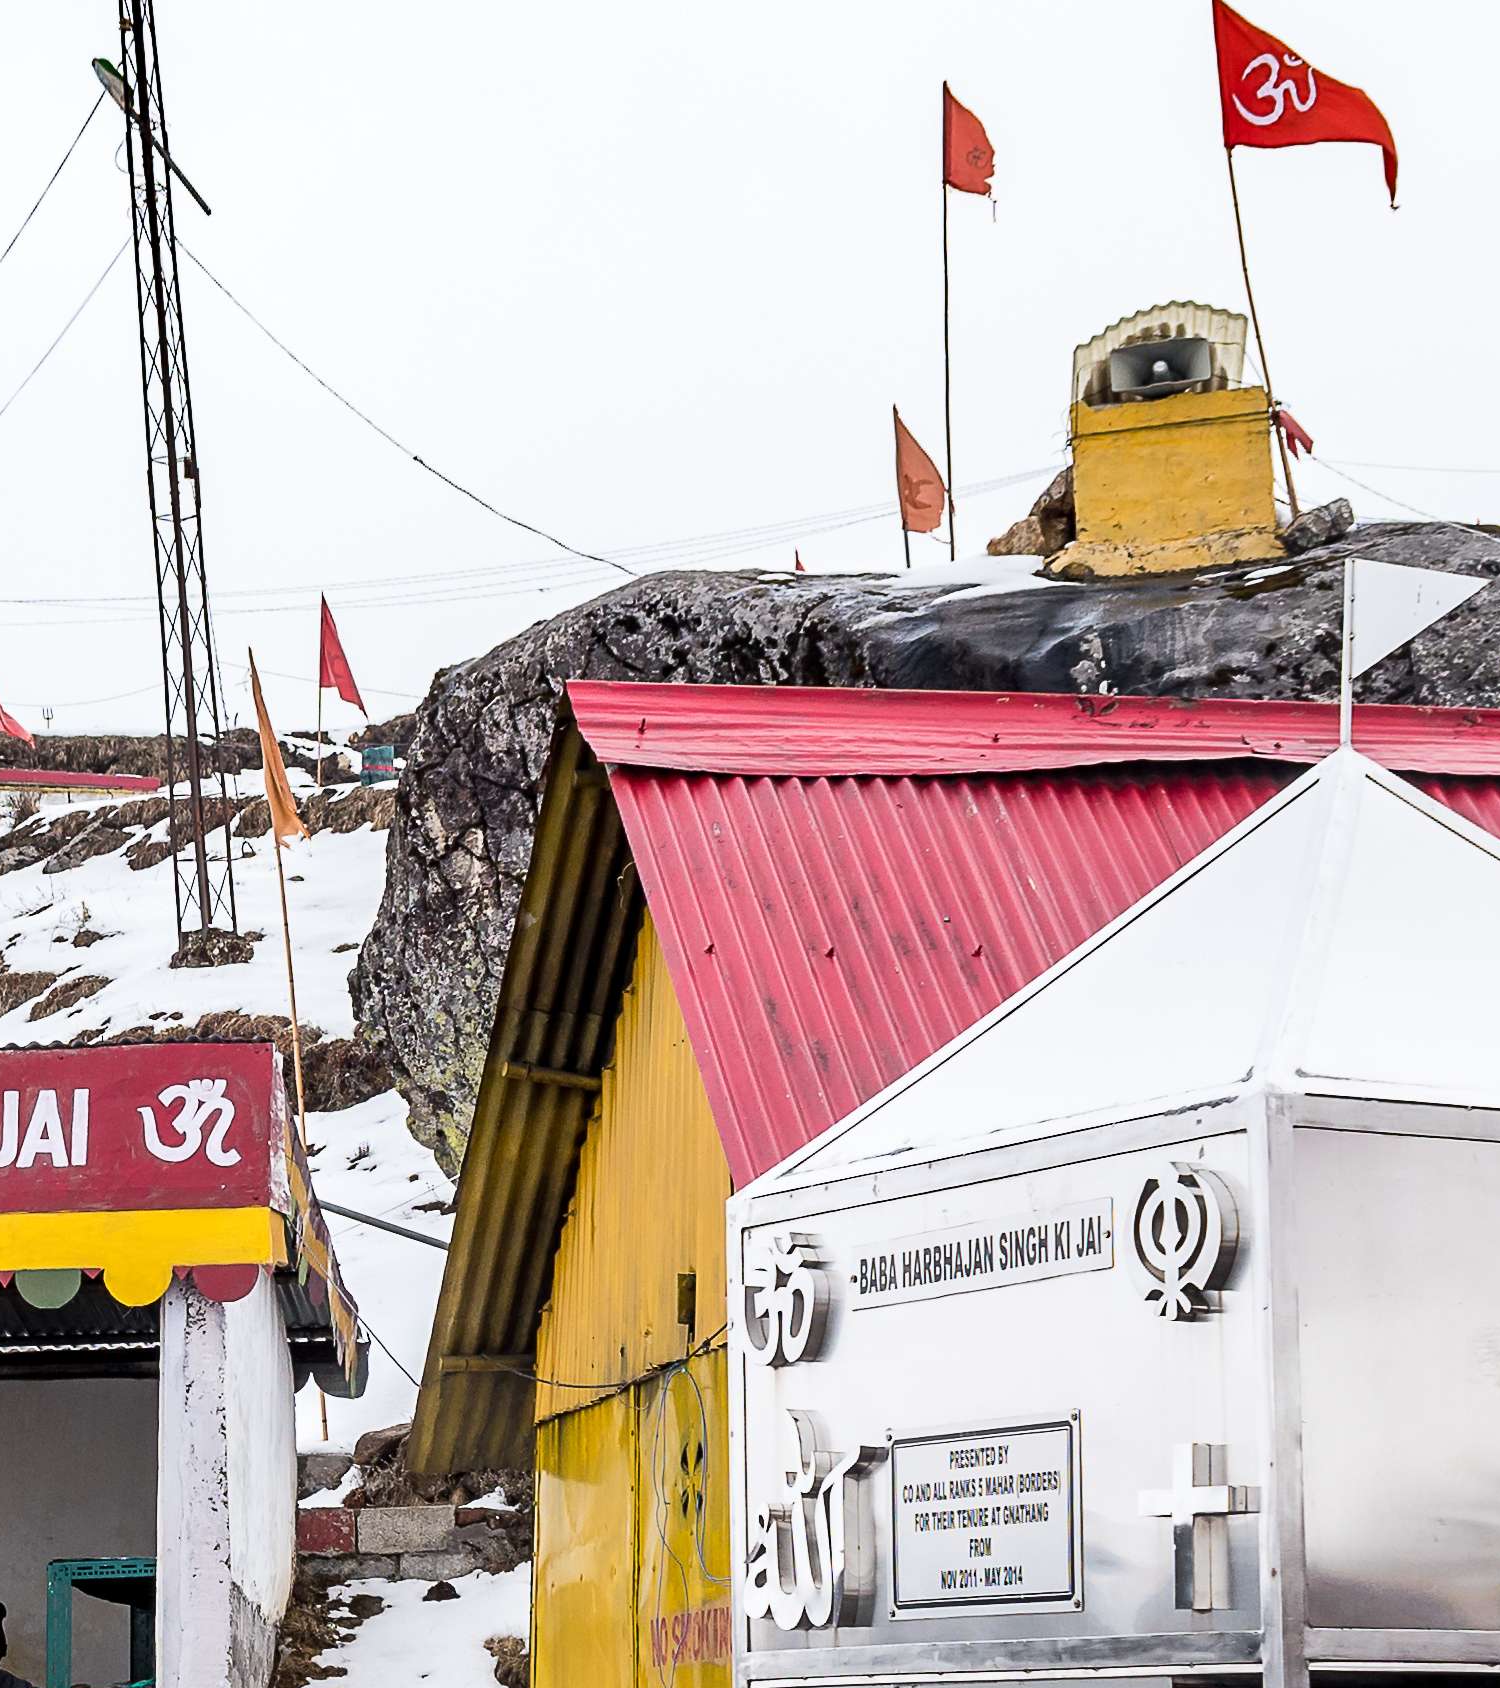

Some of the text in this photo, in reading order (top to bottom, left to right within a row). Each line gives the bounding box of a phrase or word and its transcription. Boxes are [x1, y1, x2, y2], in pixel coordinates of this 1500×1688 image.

[860, 1215, 1103, 1295] BABA HARBHAJAN SINGH KI JAI
[949, 1446, 1009, 1470] PRESENTED BY
[903, 1484, 914, 1504] CO
[916, 1482, 932, 1502] AND
[934, 1481, 947, 1501] ALL
[949, 1478, 976, 1500] RANKS
[985, 1475, 1014, 1496] MAHAR
[1016, 1471, 1061, 1499] (BORDERS)
[915, 1503, 1049, 1533] FOR THEIR TENURE AT GNATHANG
[969, 1538, 992, 1558] FROM
[941, 1570, 957, 1590] NOV
[959, 1569, 978, 1588] 2011
[984, 1567, 1001, 1586] MAY
[1003, 1565, 1023, 1585] 2014
[672, 1606, 732, 1665] SMOKIN
